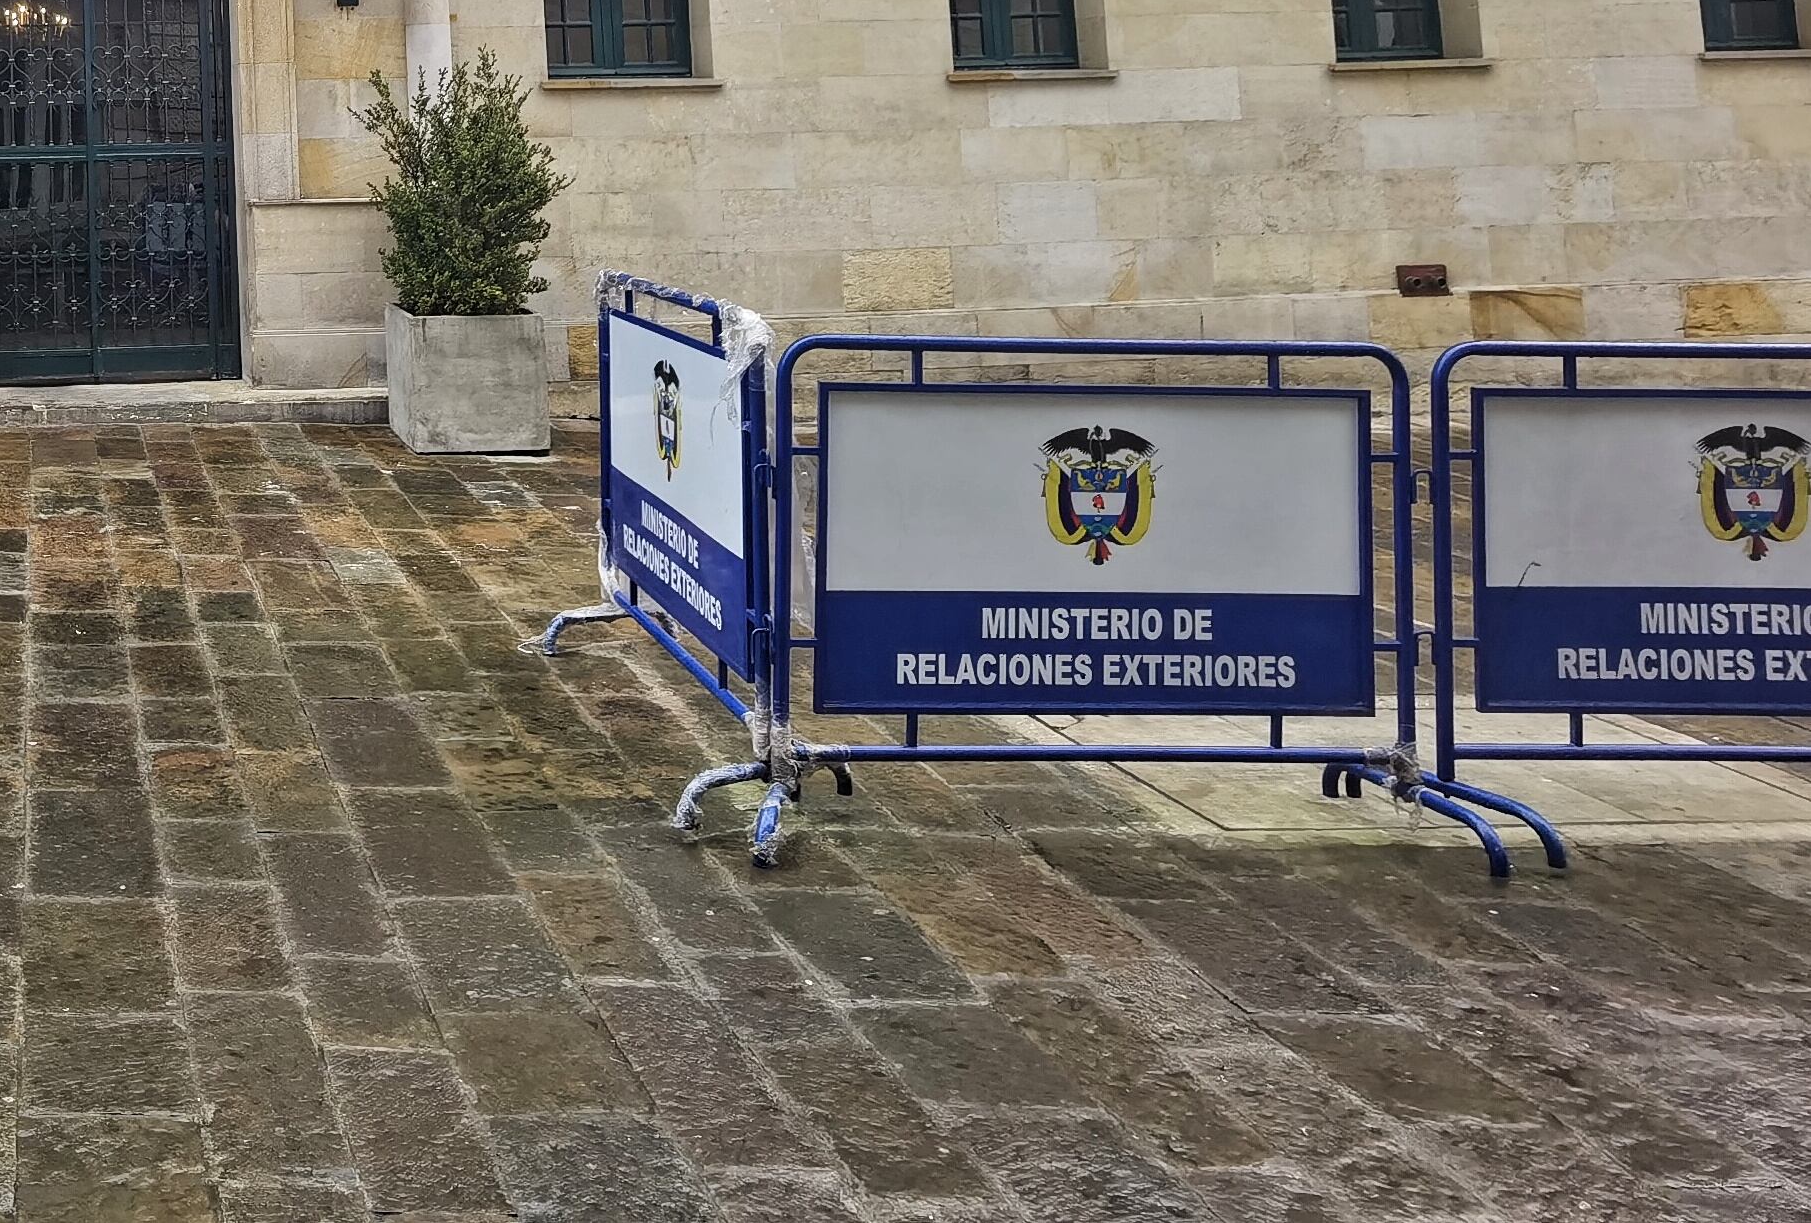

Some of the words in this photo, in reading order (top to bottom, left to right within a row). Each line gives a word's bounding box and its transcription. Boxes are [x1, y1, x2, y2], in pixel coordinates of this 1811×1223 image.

[641, 499, 687, 558] MINISTERIO
[687, 534, 700, 570] DE
[622, 523, 670, 585] RELACIONES
[670, 561, 723, 631] EXTERIORES
[980, 607, 1164, 641] MINISTERIO
[1173, 608, 1214, 641] DE
[896, 652, 1093, 687] RELACIONES
[1102, 654, 1297, 688] EXTERIORES
[1556, 647, 1756, 681] RELACIONES
